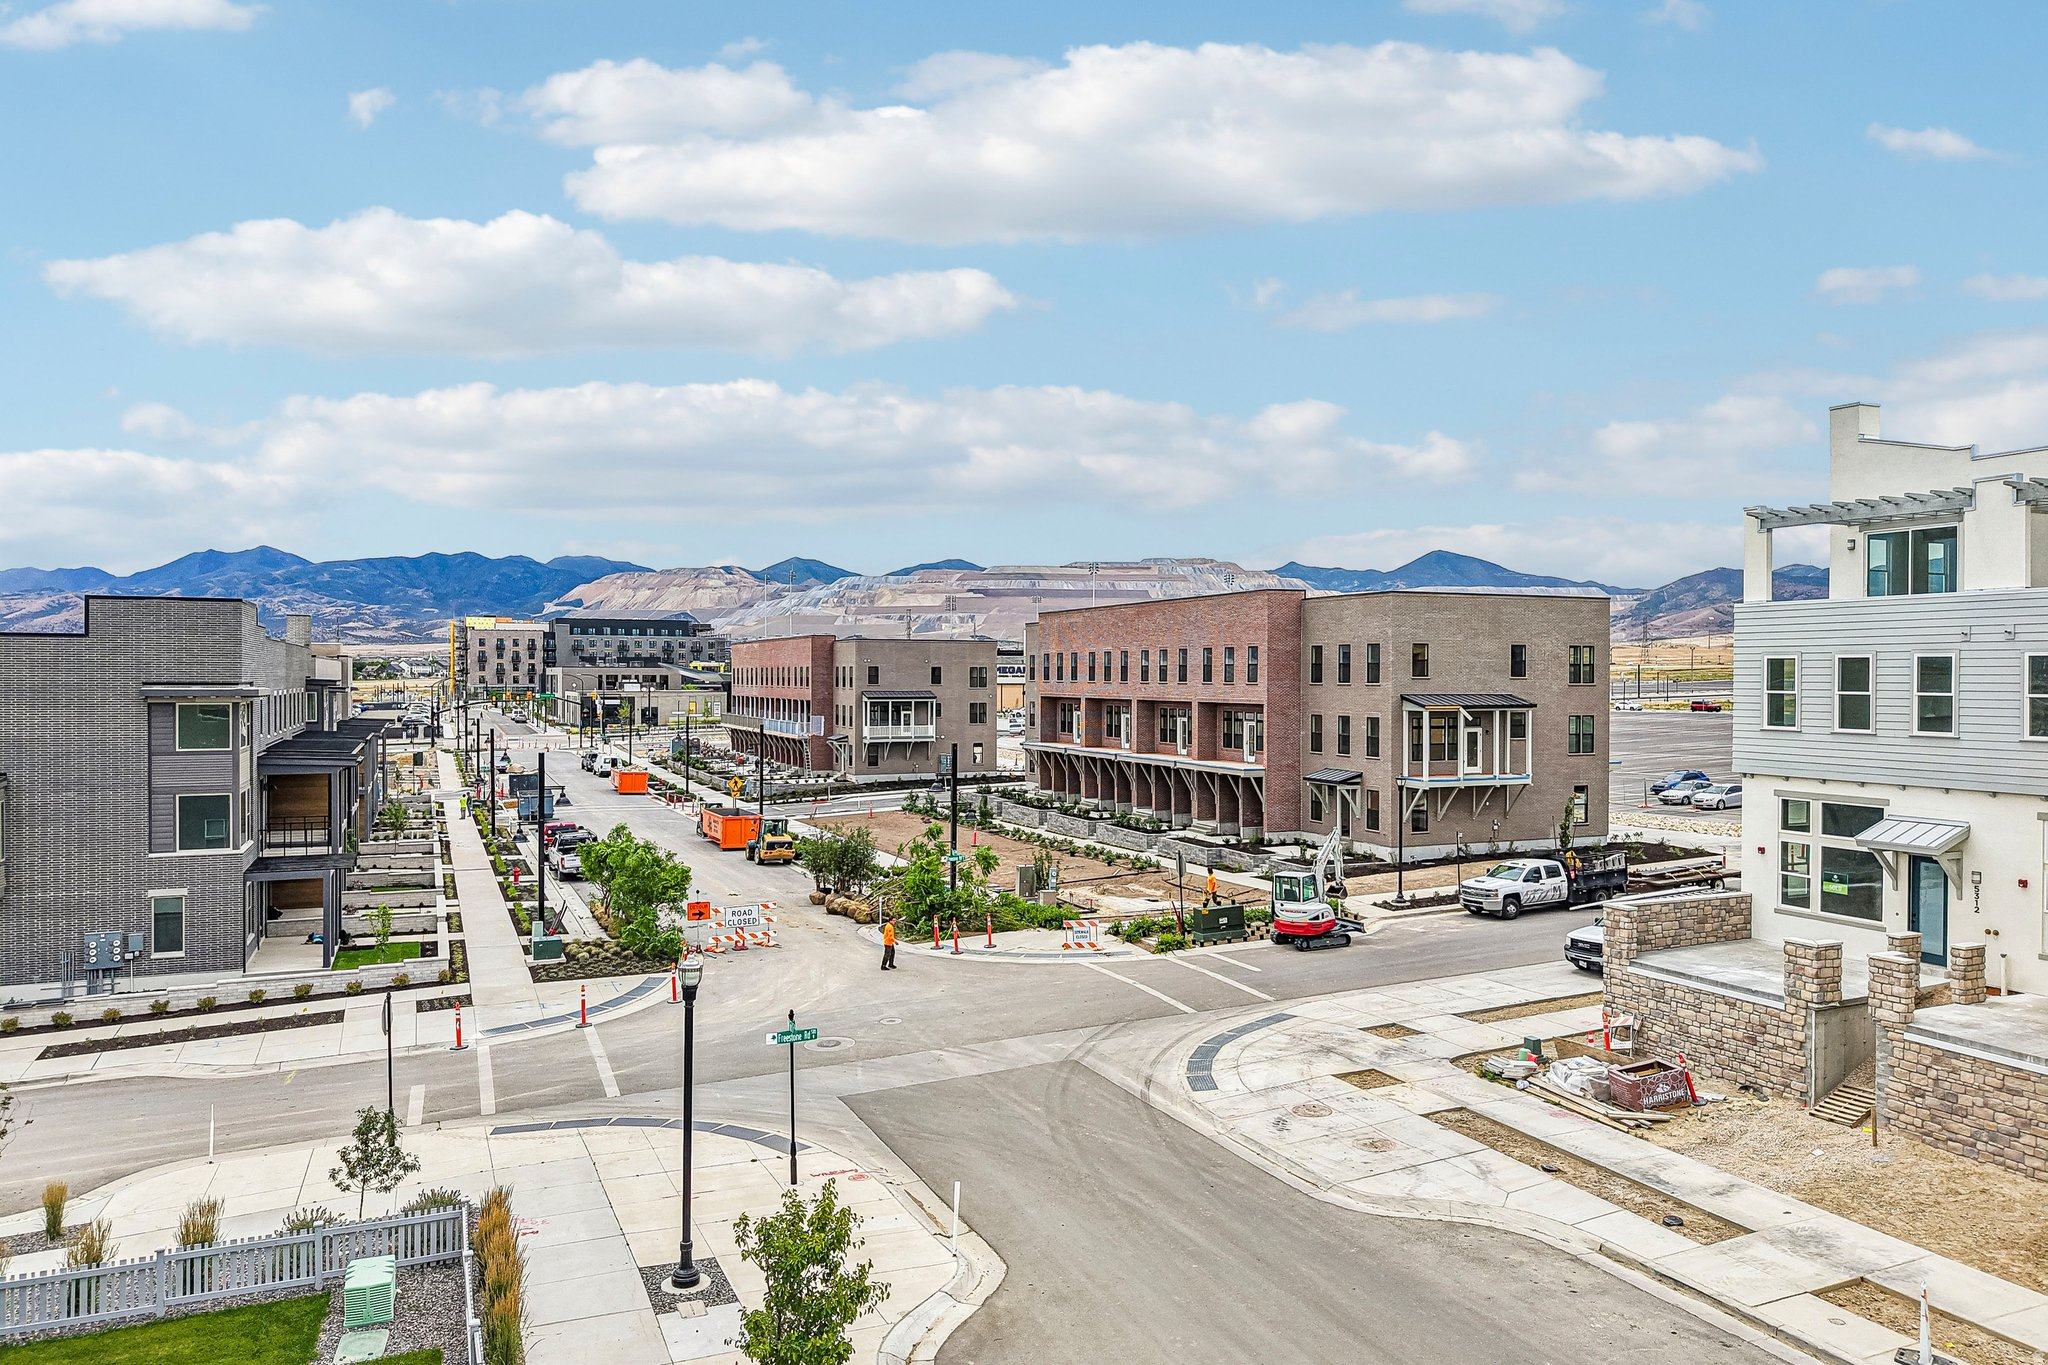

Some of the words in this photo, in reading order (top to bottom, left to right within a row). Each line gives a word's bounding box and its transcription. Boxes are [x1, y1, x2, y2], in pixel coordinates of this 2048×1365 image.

[731, 909, 753, 917] ROAD
[727, 917, 758, 927] CLOSED
[777, 1032, 802, 1043] Freestone
[803, 1030, 811, 1040] Rd
[1643, 1088, 1685, 1105] HARRISTONE
